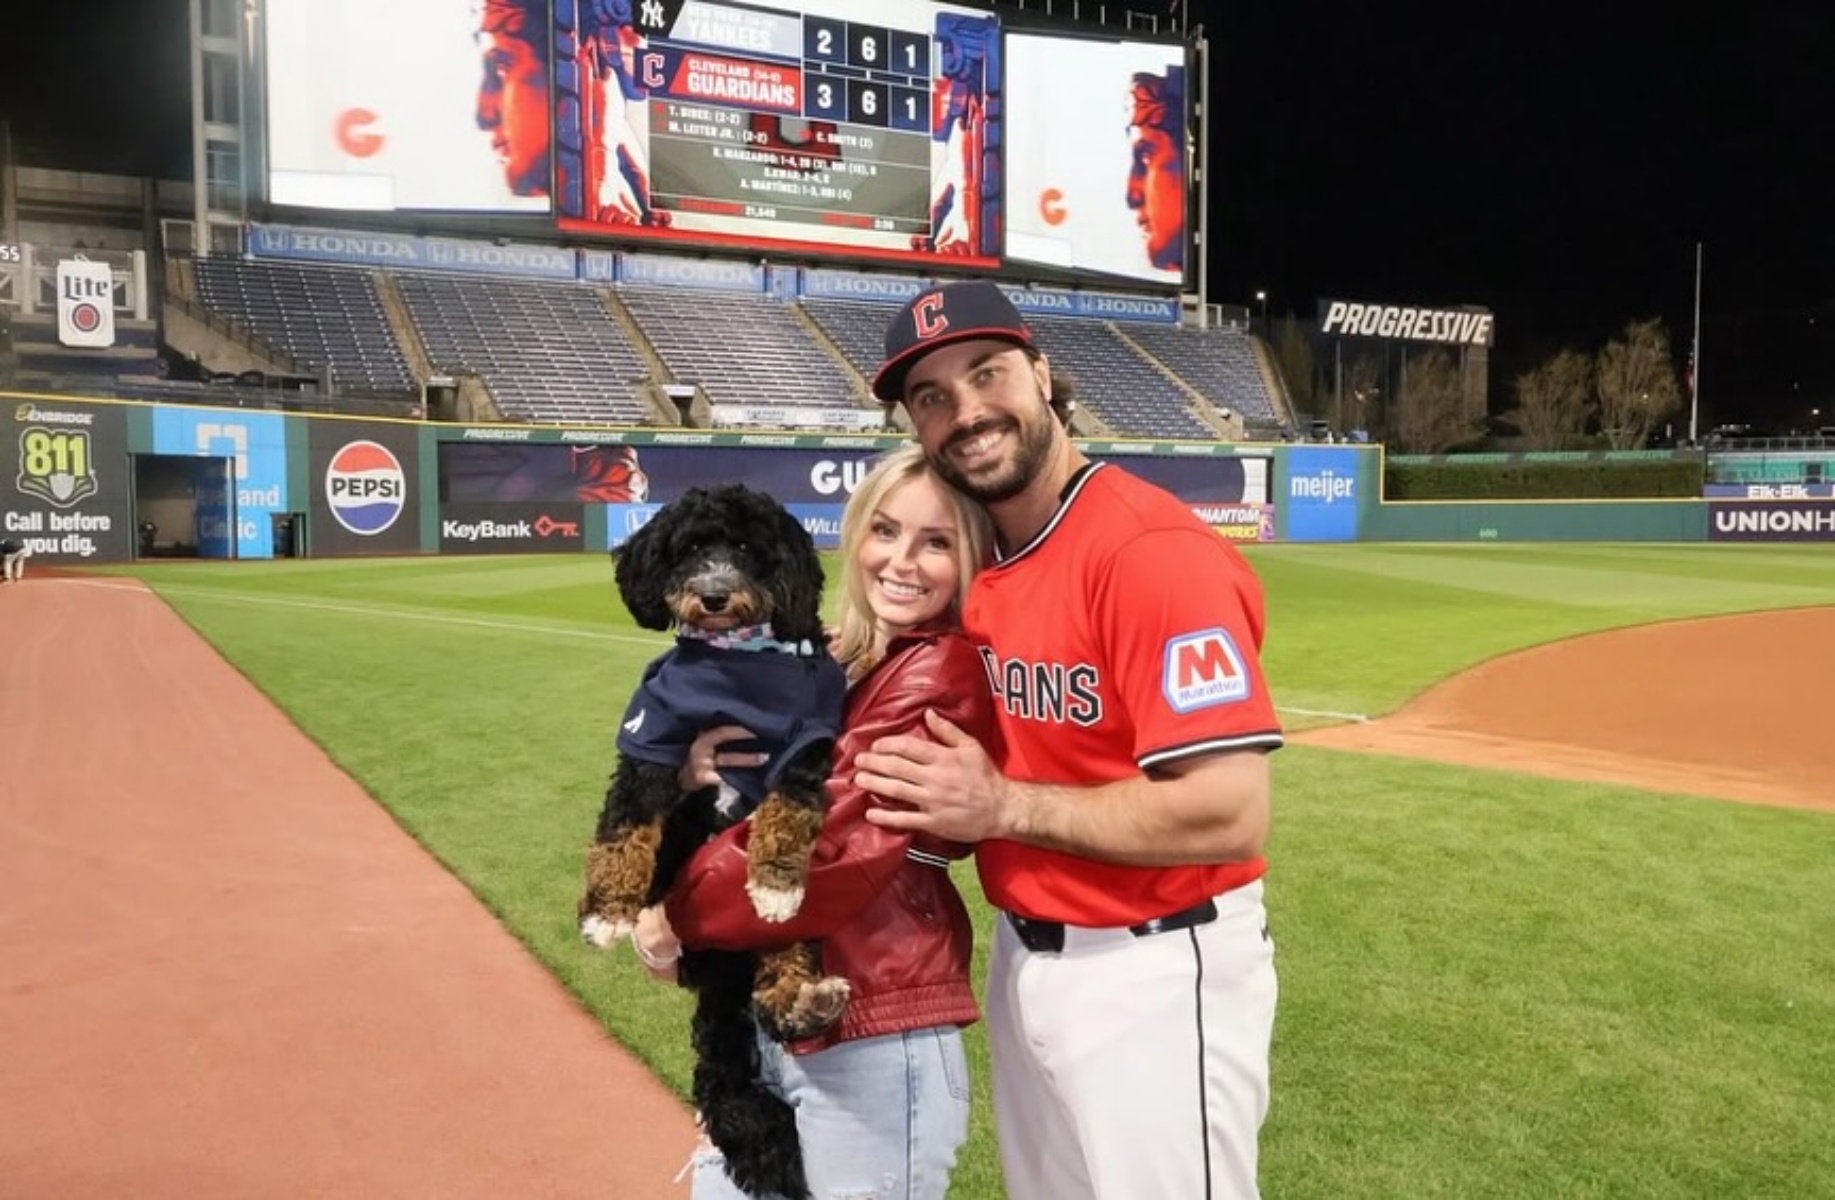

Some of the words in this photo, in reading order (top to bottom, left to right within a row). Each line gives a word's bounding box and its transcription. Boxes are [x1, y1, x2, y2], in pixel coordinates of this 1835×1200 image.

[687, 20, 772, 49] YANKEES
[817, 28, 832, 55] 2
[861, 36, 876, 62] 6
[904, 44, 916, 68] 1
[643, 53, 665, 88] C
[687, 71, 795, 107] GUARDIANS
[817, 83, 832, 109] 3
[861, 90, 876, 115] 6
[904, 97, 916, 120] 1
[290, 234, 418, 260] HONDA
[456, 248, 570, 270] HONDA
[655, 261, 755, 284] HONDA
[64, 275, 109, 301] Lite
[834, 278, 921, 297] HONDA
[1003, 288, 1073, 309] ONDA
[912, 292, 949, 338] C
[1097, 298, 1172, 316] HONDA
[1322, 301, 1495, 345] PROGRESSIVE
[25, 431, 87, 477] 811
[332, 477, 401, 498] PEPSI
[1291, 469, 1355, 503] meijer
[5, 511, 43, 532] Call
[50, 511, 111, 532] before
[443, 520, 532, 541] KeyBank
[23, 536, 58, 557] you
[61, 533, 97, 557] dig.
[1177, 639, 1238, 689] M
[1179, 681, 1243, 704] Marathon
